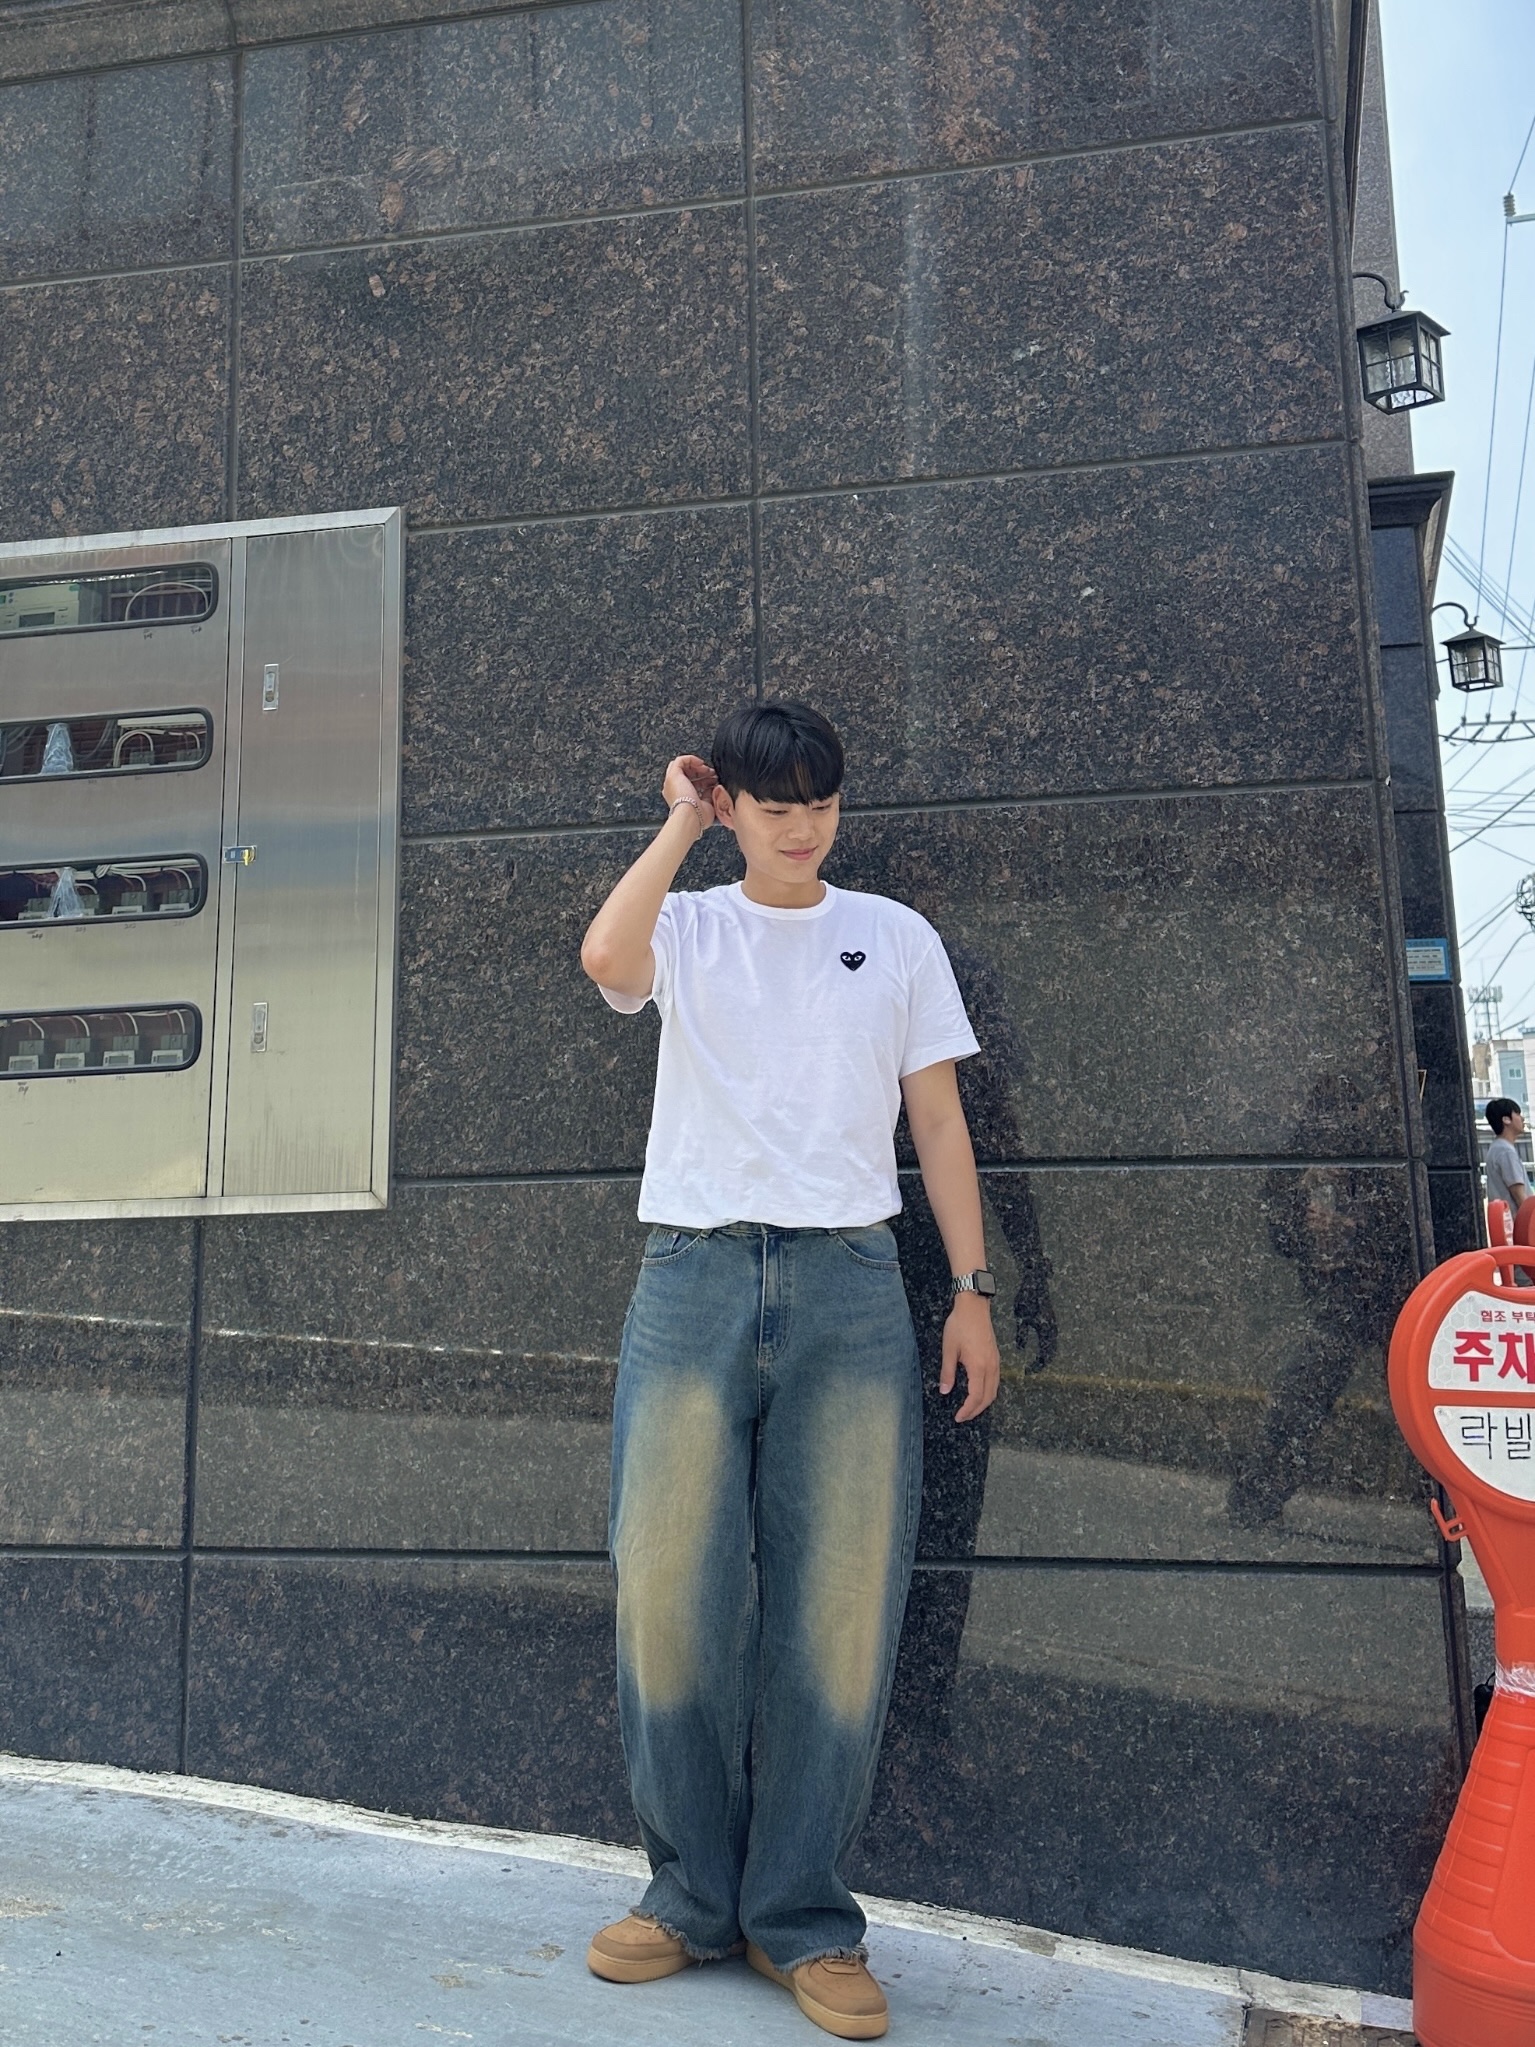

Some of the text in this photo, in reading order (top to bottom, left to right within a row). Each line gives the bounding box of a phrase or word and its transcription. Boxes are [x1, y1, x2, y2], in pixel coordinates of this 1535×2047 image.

[1481, 1310, 1506, 1322] 협조
[1454, 1331, 1535, 1384] 주차
[1460, 1412, 1531, 1460] 락빌
